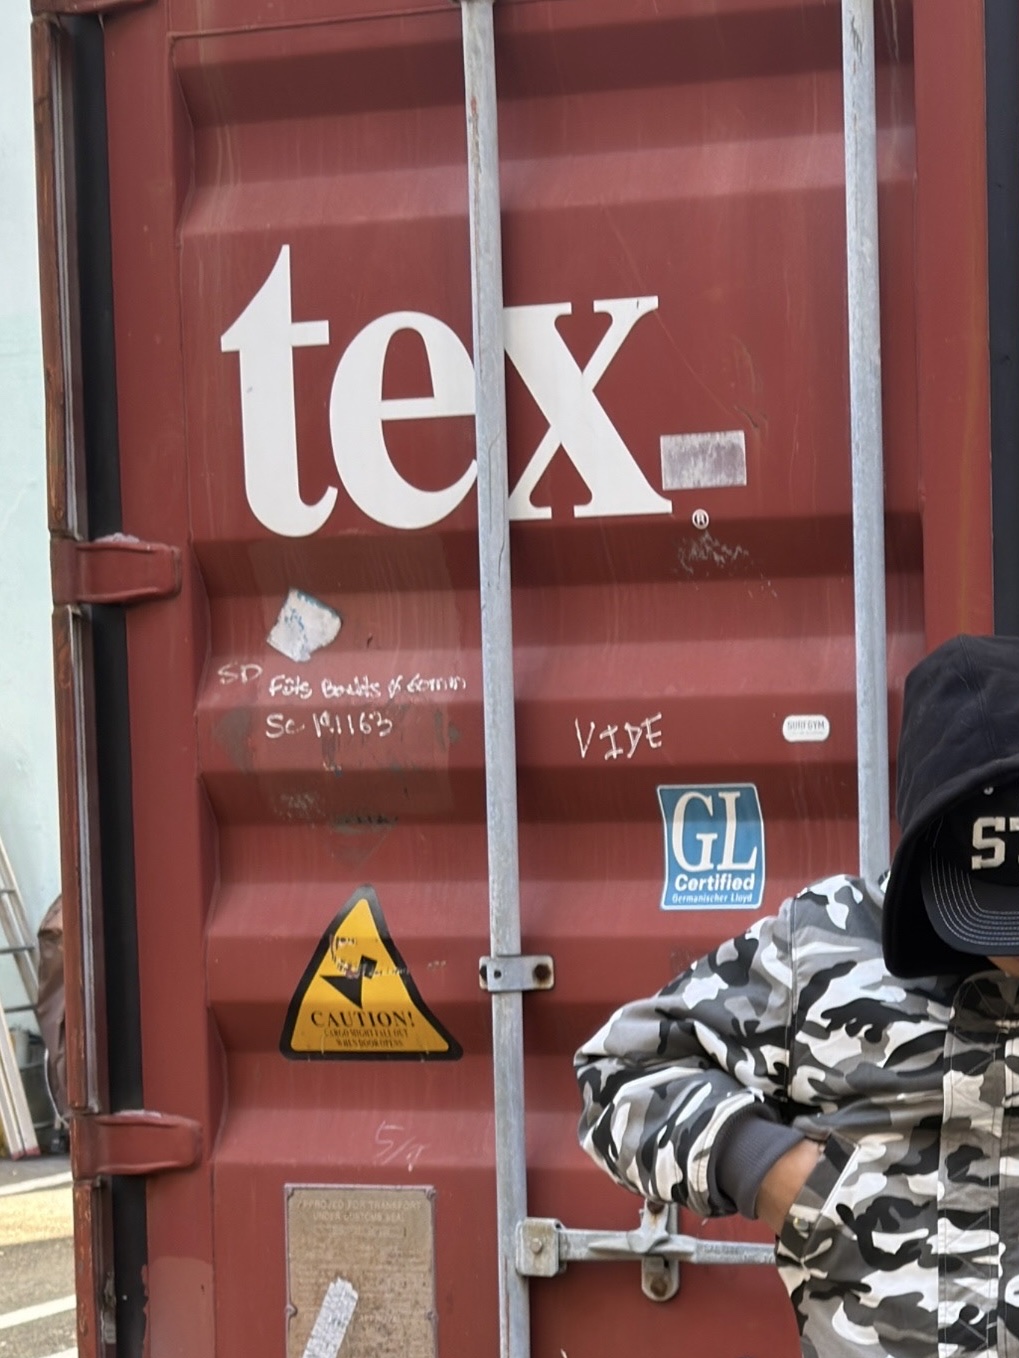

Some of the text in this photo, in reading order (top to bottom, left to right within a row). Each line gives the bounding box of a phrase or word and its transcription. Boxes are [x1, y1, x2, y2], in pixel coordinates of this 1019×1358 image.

[220, 243, 672, 537] tex
[672, 791, 758, 873] GL
[675, 873, 756, 892] Certified
[310, 1010, 416, 1029] CAUTION!
